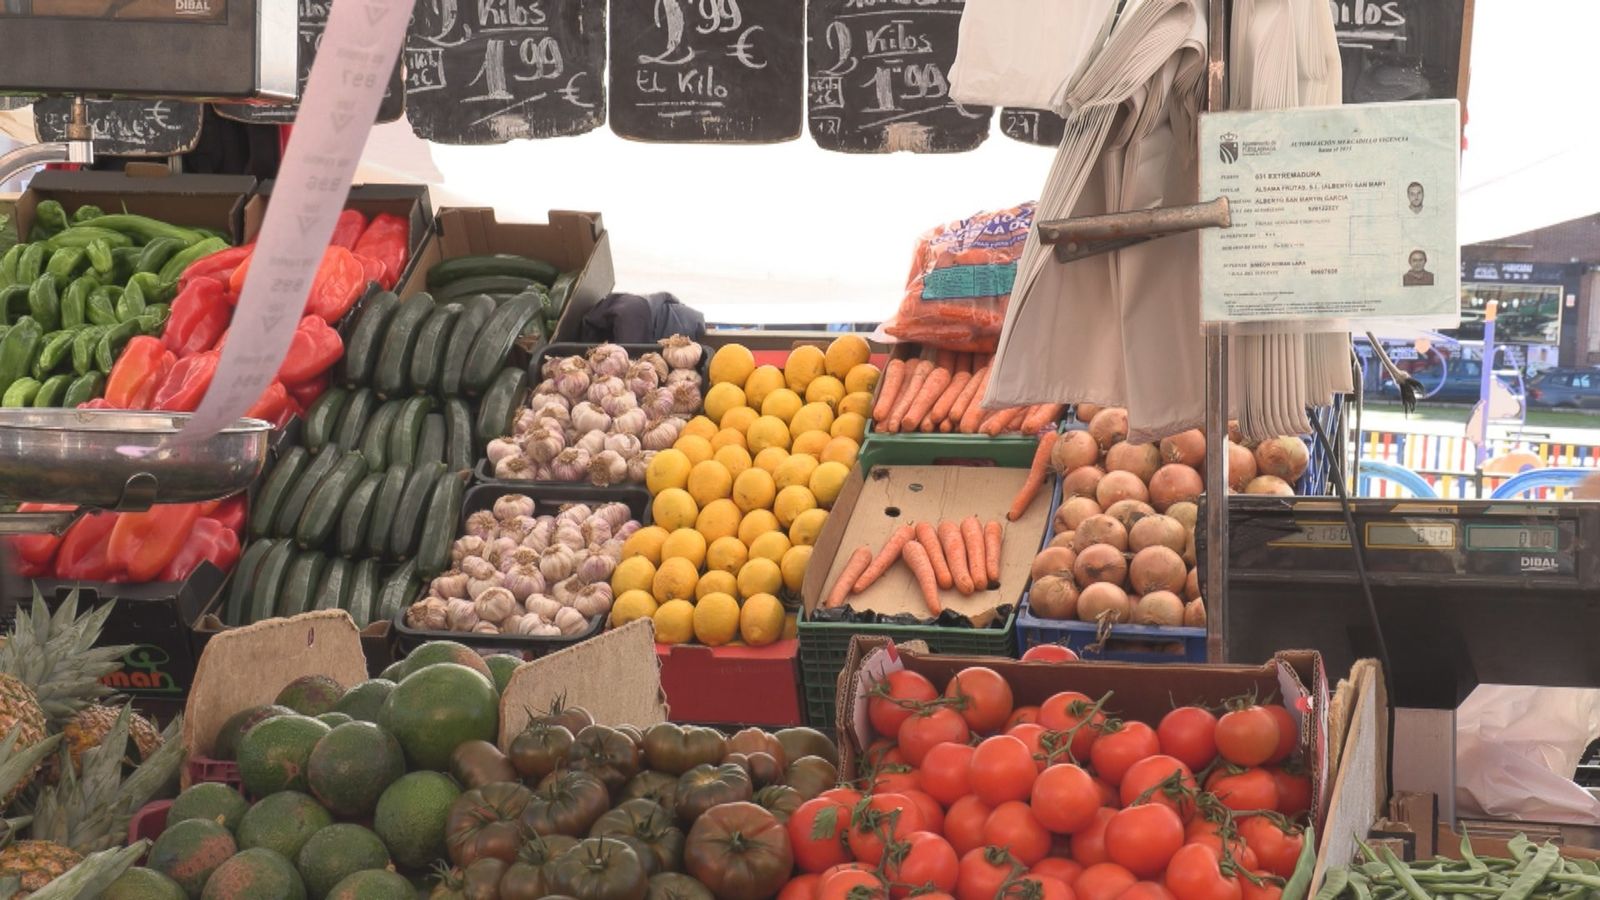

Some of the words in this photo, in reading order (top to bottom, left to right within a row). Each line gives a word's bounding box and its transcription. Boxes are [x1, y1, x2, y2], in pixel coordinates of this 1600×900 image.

[175, 0, 211, 10] DIBAL
[478, 0, 546, 26] Kilos
[725, 25, 768, 69] €
[865, 23, 933, 53] Kilos
[554, 71, 594, 107] €
[678, 66, 728, 98] Kilo
[1268, 171, 1321, 179] EXTREMADURA
[1520, 556, 1560, 568] DIBAL
